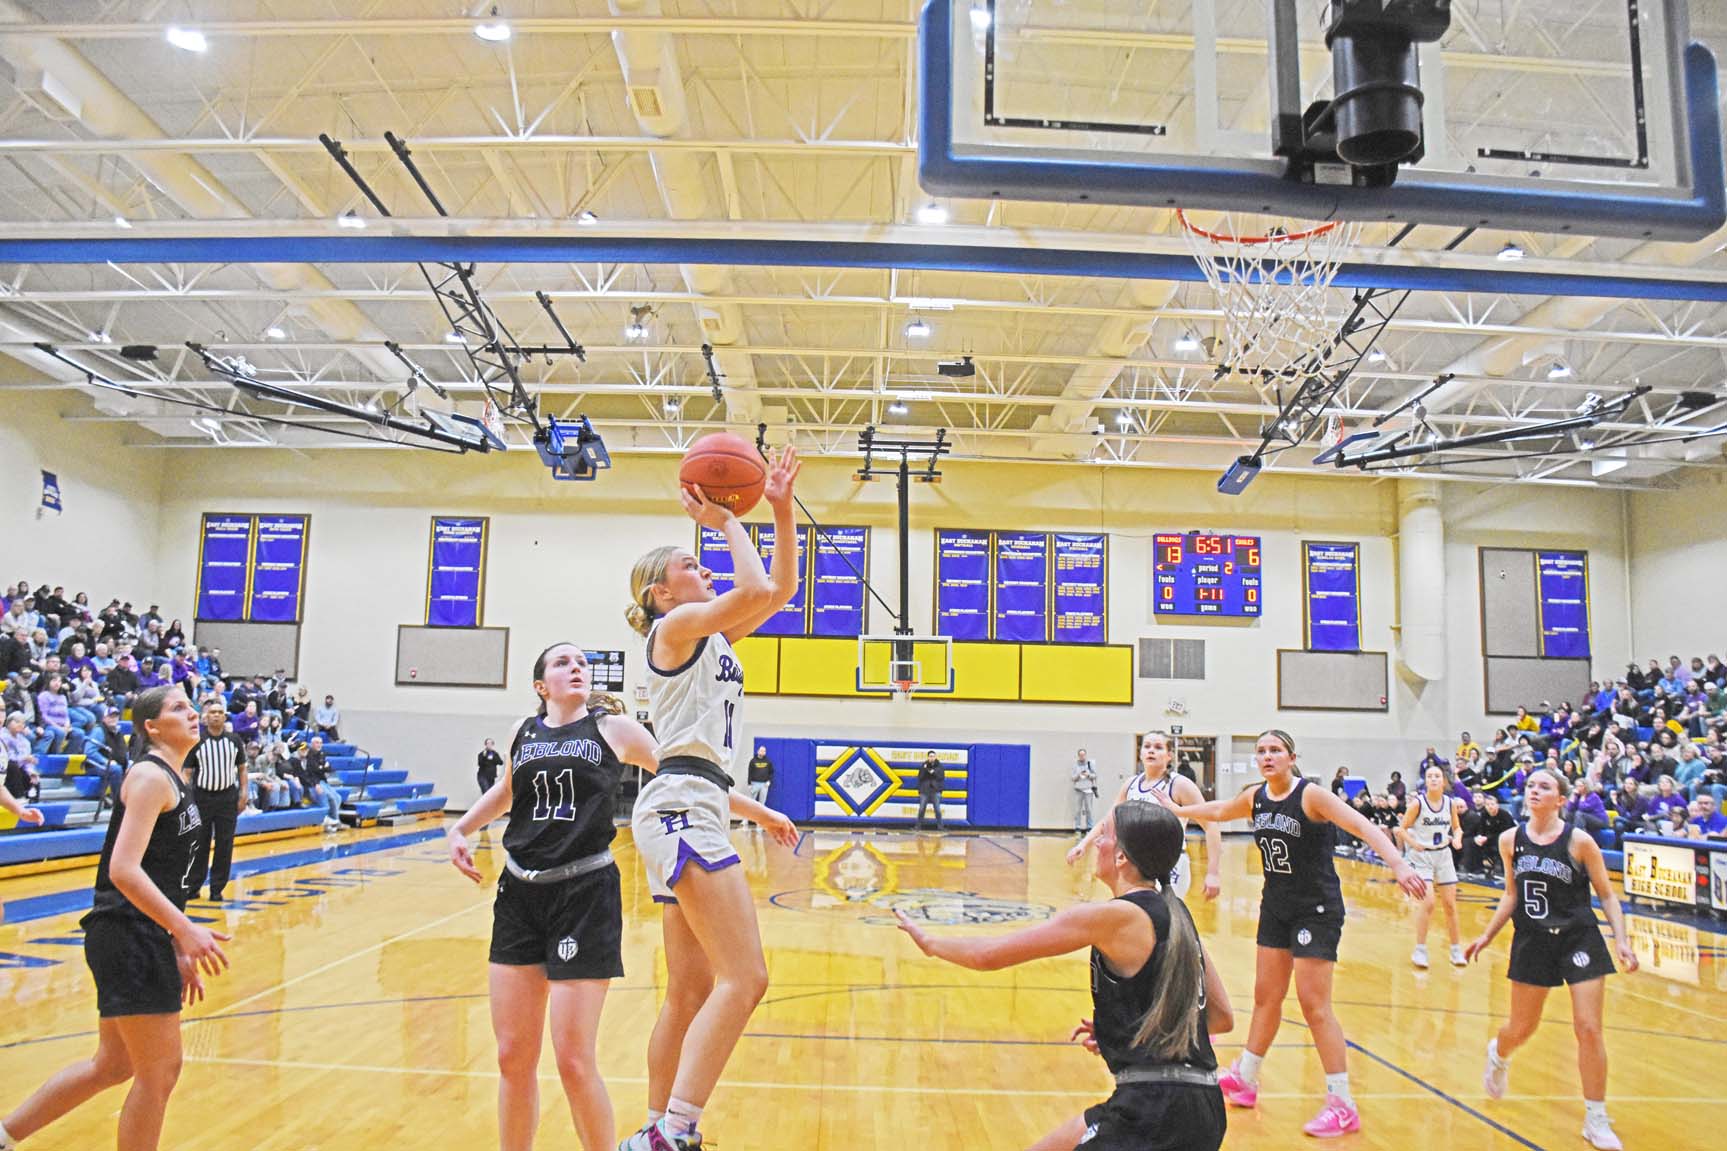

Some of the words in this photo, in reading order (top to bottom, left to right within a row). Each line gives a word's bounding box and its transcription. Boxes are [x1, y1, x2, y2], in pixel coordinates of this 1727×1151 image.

[1196, 536, 1231, 554] 6:51
[1167, 546, 1182, 563] 13
[1248, 548, 1260, 566] 6
[1224, 561, 1233, 575] 2
[1164, 586, 1172, 599] 0
[1247, 588, 1257, 602] 0
[512, 738, 602, 775] LEBLOND
[532, 768, 577, 821] 11
[1259, 837, 1292, 874] 12
[1524, 879, 1549, 919] 5
